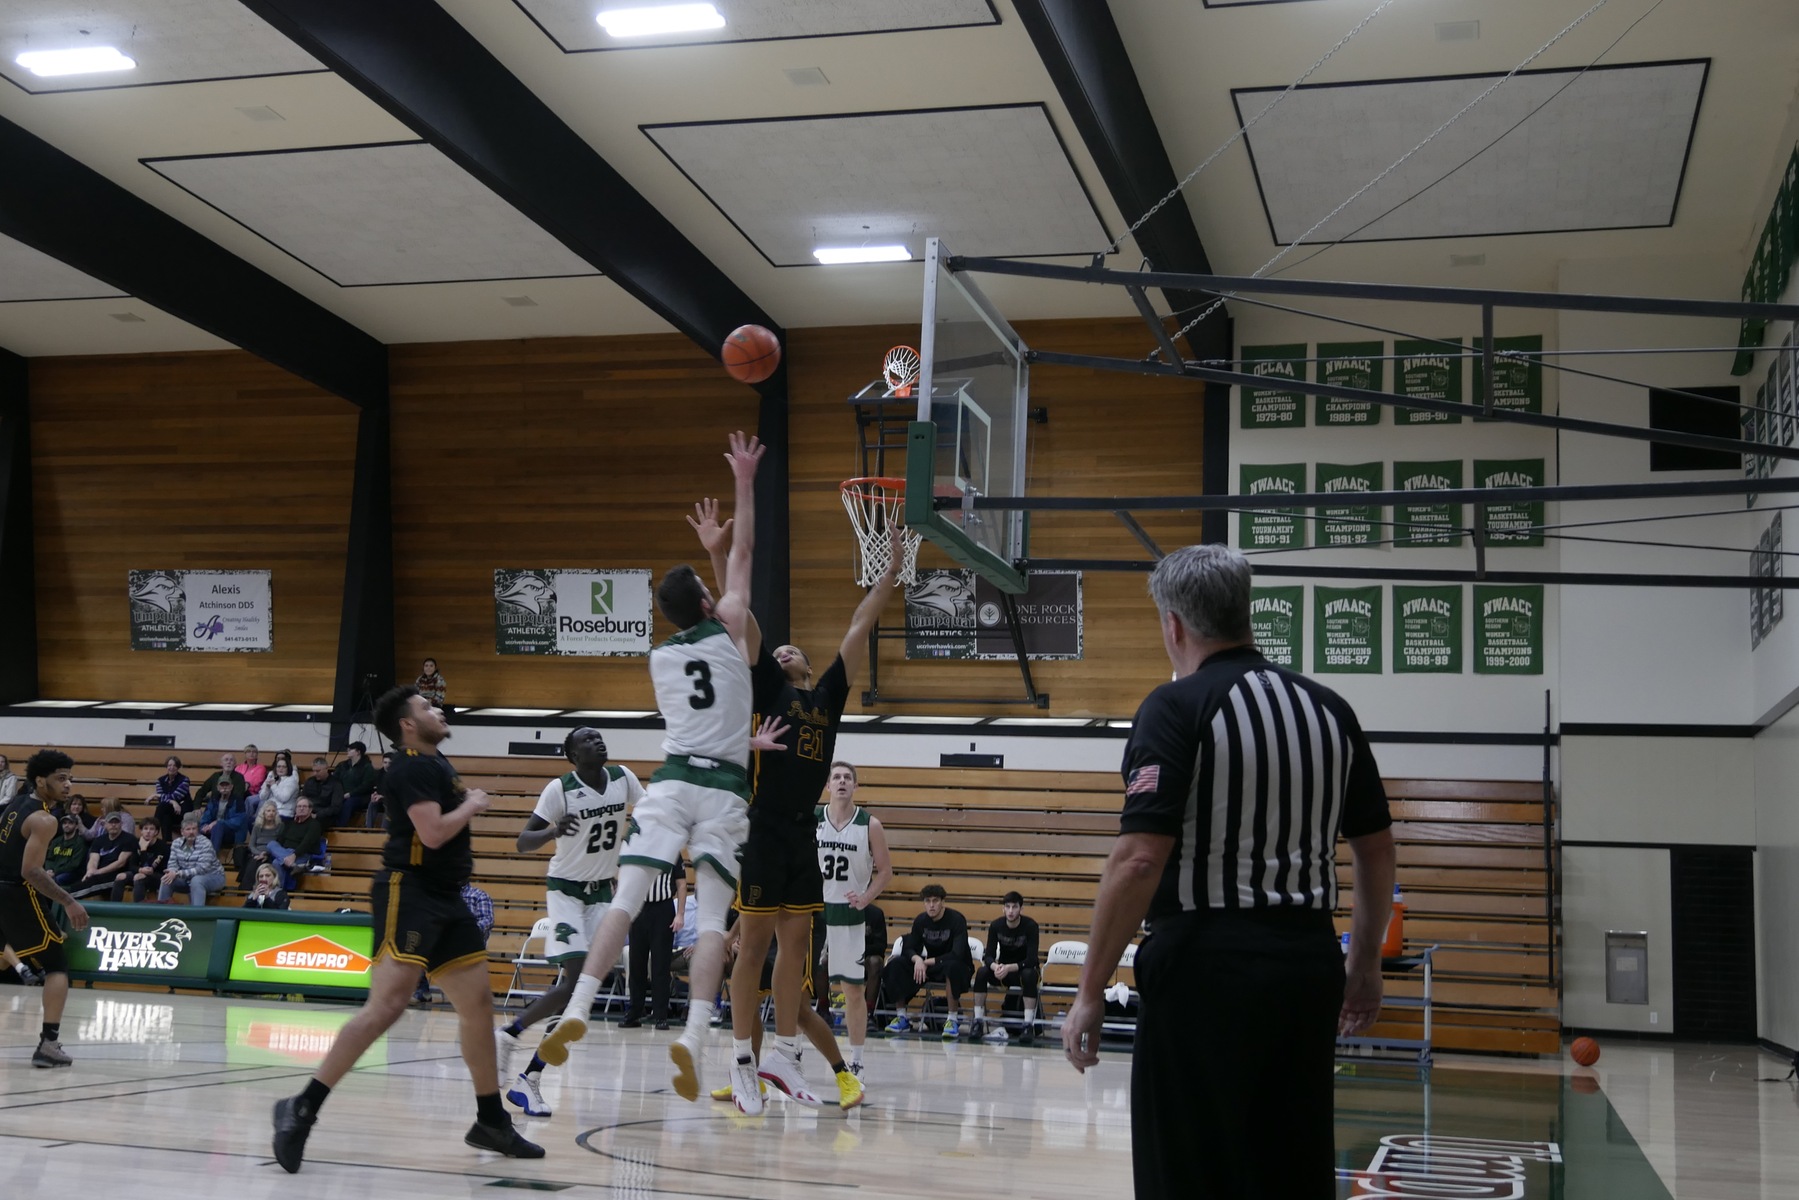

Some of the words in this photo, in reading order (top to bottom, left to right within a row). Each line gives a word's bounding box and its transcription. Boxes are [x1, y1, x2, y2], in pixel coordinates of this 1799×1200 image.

[1326, 356, 1371, 375] NWAACC
[1404, 353, 1450, 372] NWAACC
[1252, 403, 1296, 412] CHAMPIONS
[1326, 403, 1371, 411] CHAMPIONS
[1250, 477, 1295, 495] NWAACC
[1325, 477, 1370, 493] NWAACC
[1404, 474, 1450, 491] NWAACC
[1485, 472, 1533, 489] NWAACC
[1487, 521, 1532, 529] TOURNAMENT
[1254, 535, 1290, 544] 1990-91
[212, 584, 240, 594] Alexis
[1010, 604, 1037, 614] ONE
[1041, 604, 1075, 614] ROCK
[1325, 599, 1371, 618] NWAACC
[1403, 598, 1450, 617] NWAACC
[1483, 597, 1532, 617] NWAACC
[500, 613, 555, 626] Umpqua
[560, 616, 646, 637] Roseburg
[909, 614, 975, 629] Umpqua
[1004, 616, 1076, 624] SOURCES
[1256, 646, 1291, 655] NAMENT
[1483, 647, 1532, 655] CHAMPIONS
[1264, 655, 1292, 664] 5-96
[1486, 656, 1530, 666] 1999-2000
[685, 660, 715, 710] 3
[797, 725, 824, 762] 21
[580, 803, 624, 819] Umpqua
[587, 820, 617, 853] 23
[817, 840, 857, 851] Umpqua
[823, 855, 848, 881] 32
[86, 927, 157, 952] RIVER
[98, 949, 179, 972] HAWKS
[276, 950, 348, 968] SERVPRO
